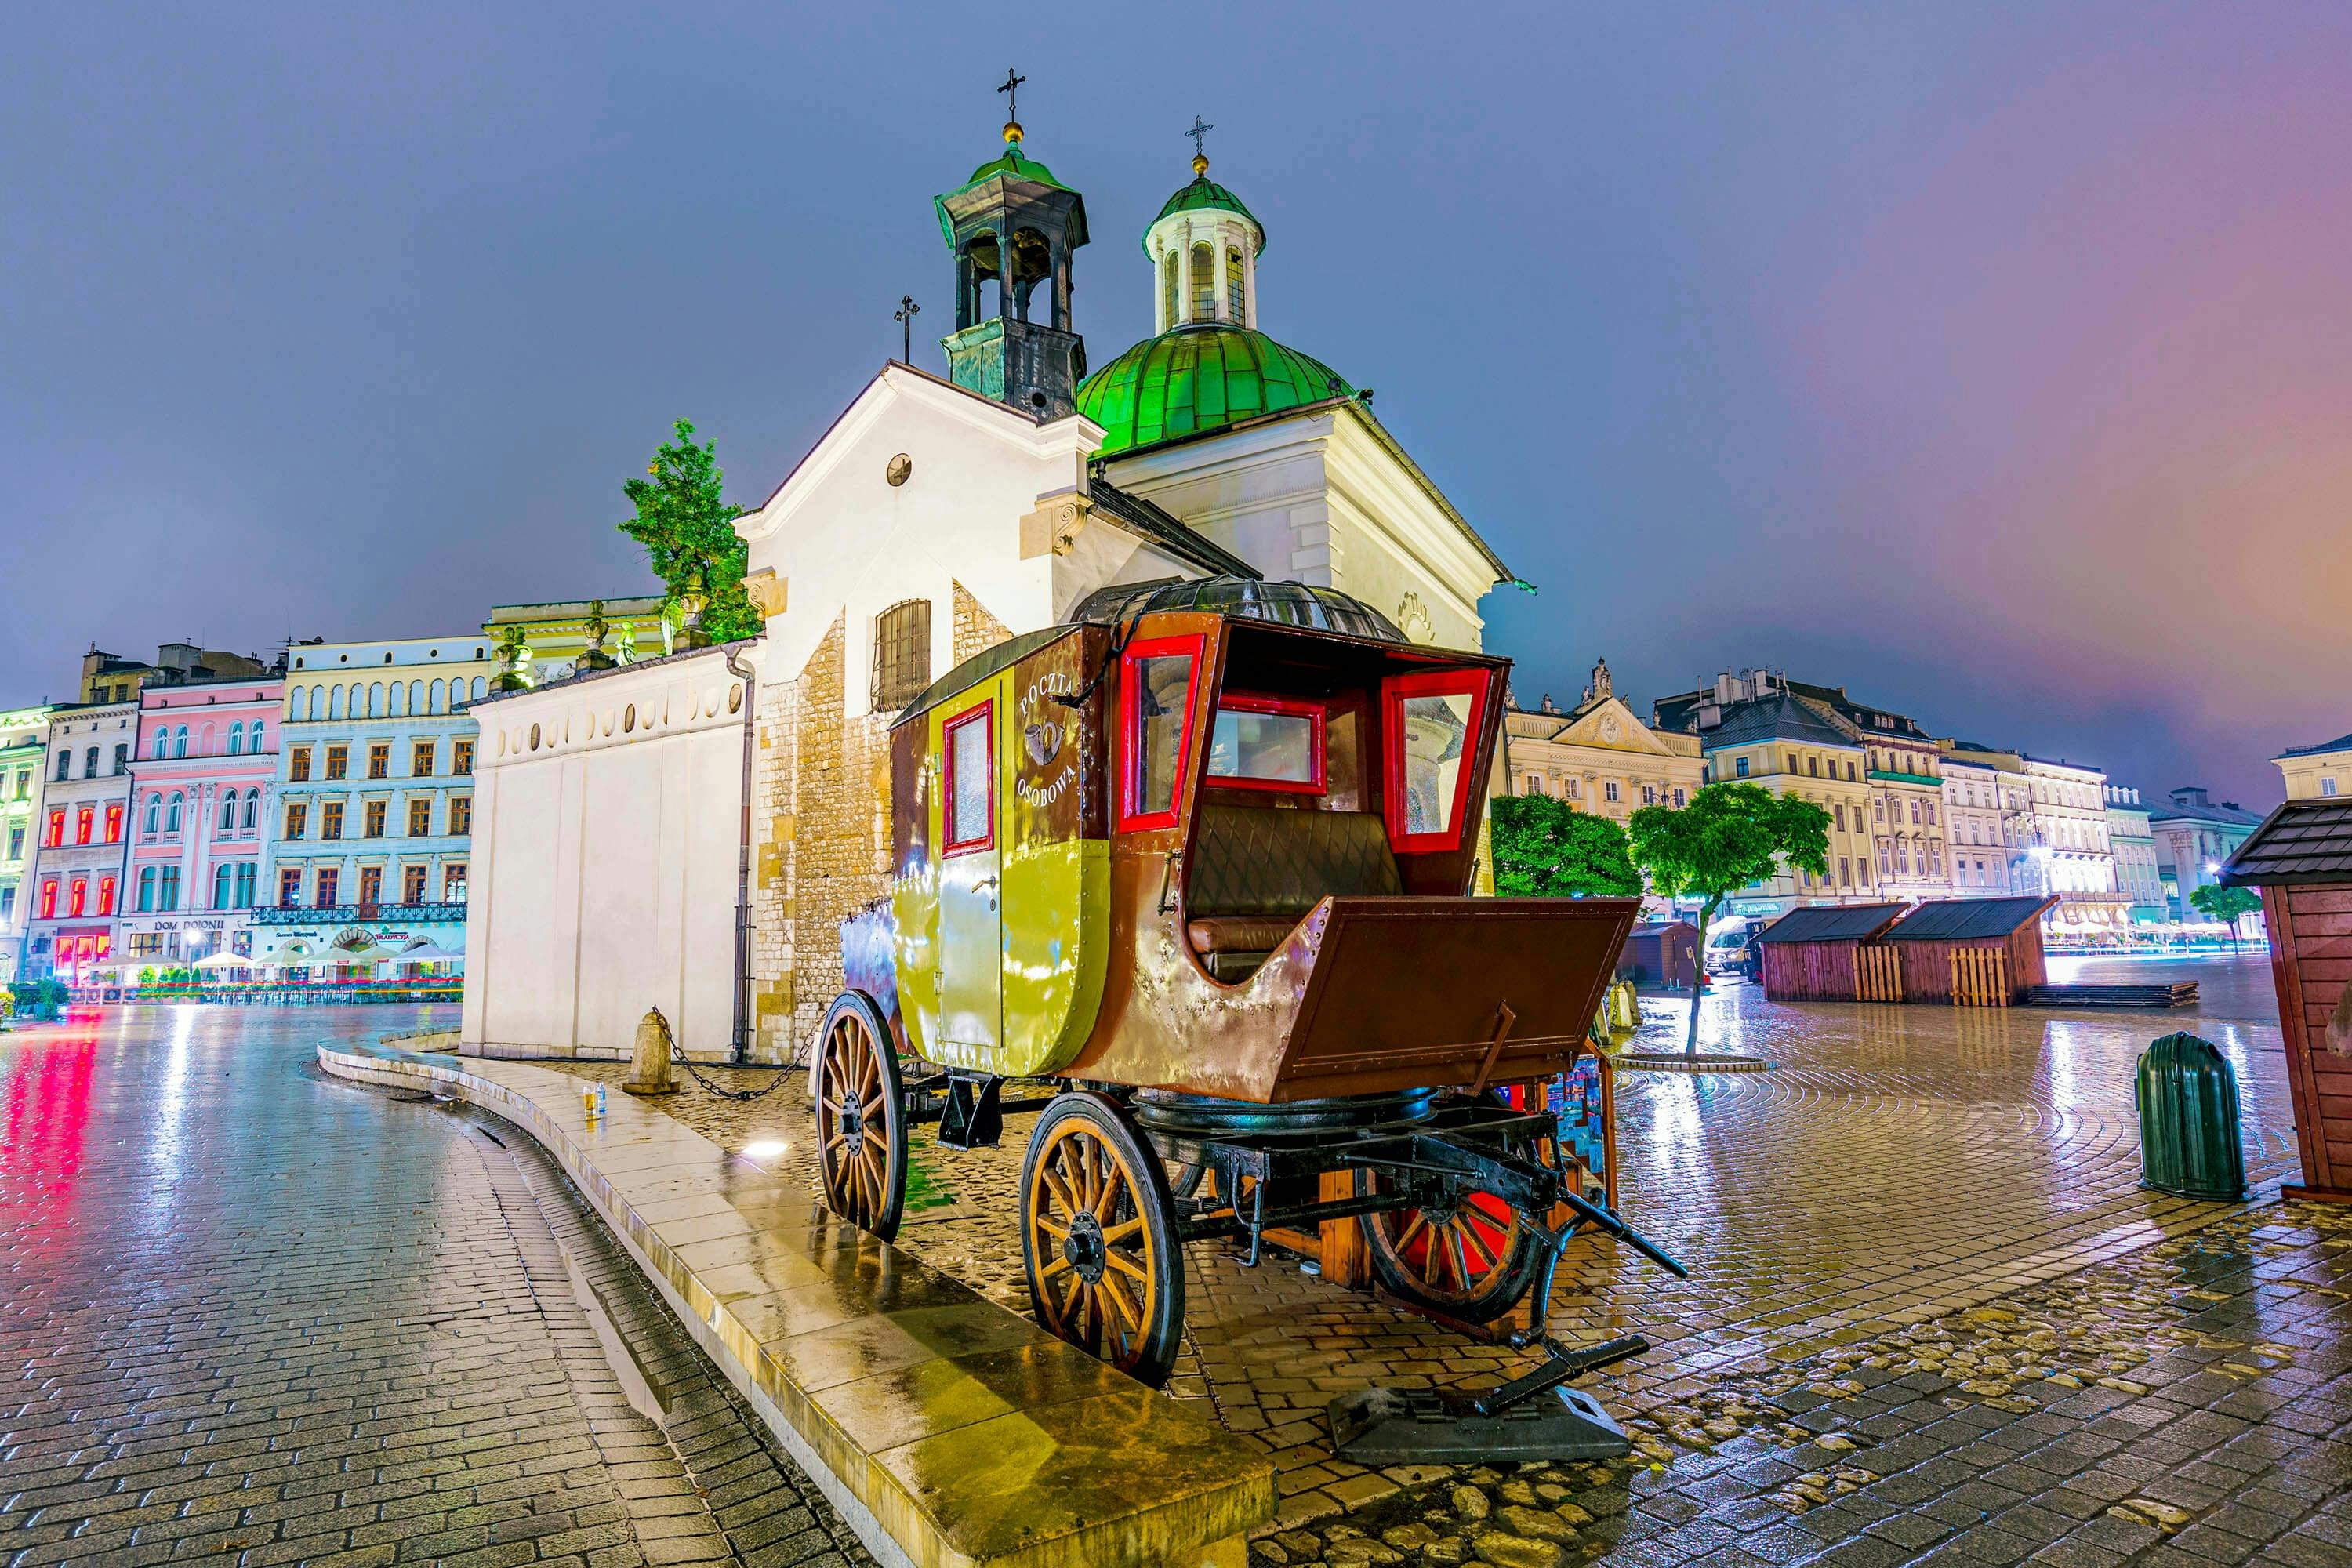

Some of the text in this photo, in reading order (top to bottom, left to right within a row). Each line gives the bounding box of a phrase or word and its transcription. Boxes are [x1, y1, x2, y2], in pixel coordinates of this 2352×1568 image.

[1020, 673, 1073, 717] POCZTA
[1018, 765, 1076, 807] OSOBOWA
[154, 921, 177, 931] DOM
